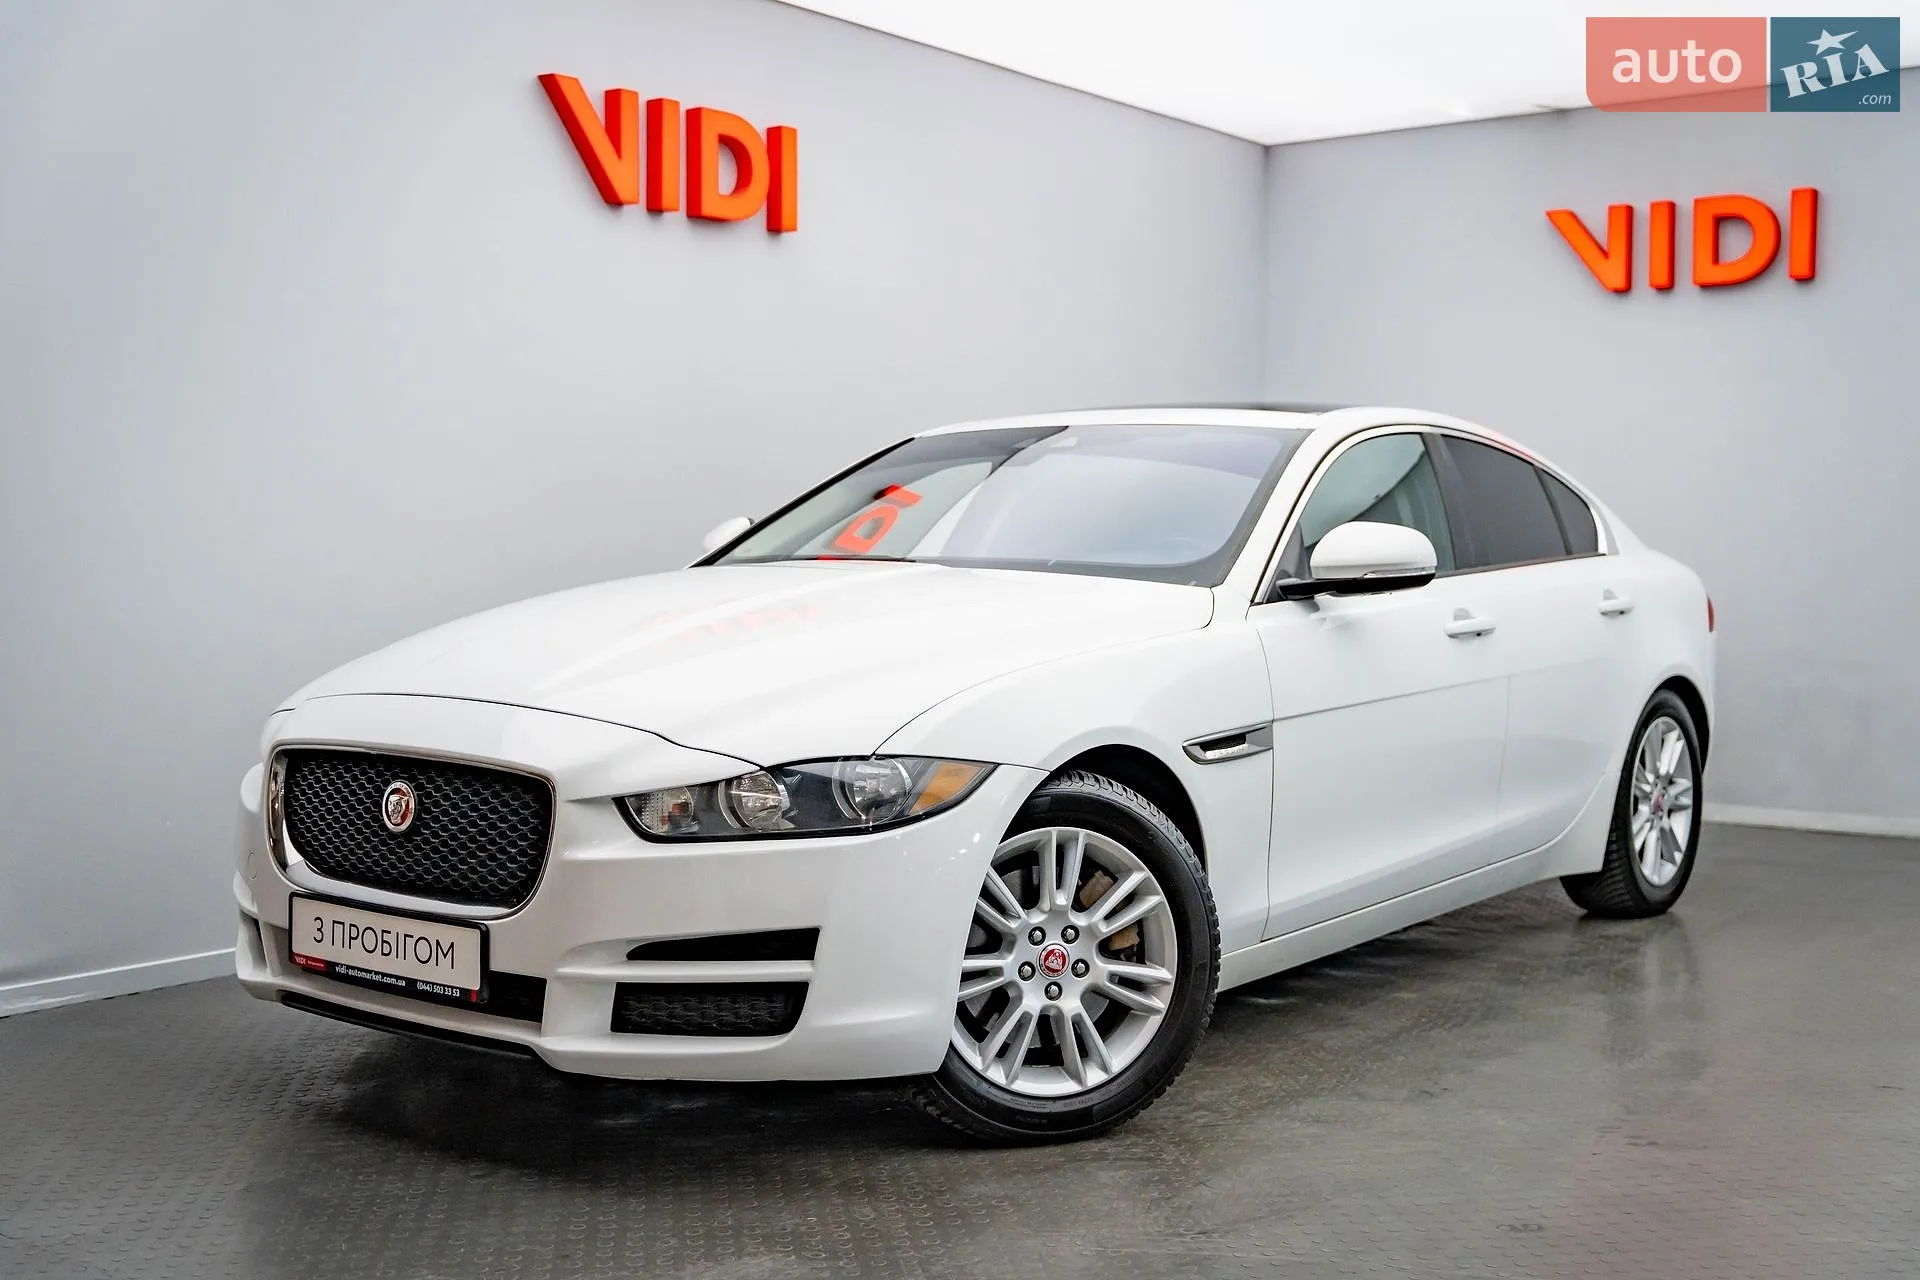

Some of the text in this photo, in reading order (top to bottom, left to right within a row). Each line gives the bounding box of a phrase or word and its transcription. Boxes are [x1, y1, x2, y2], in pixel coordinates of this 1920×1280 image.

[537, 73, 798, 233] VIDI
[1545, 186, 1819, 293] VIDI
[331, 919, 455, 969] ПРОБІГОМ
[335, 964, 406, 987] vidi-automarket.com.ua
[433, 985, 444, 994] 503
